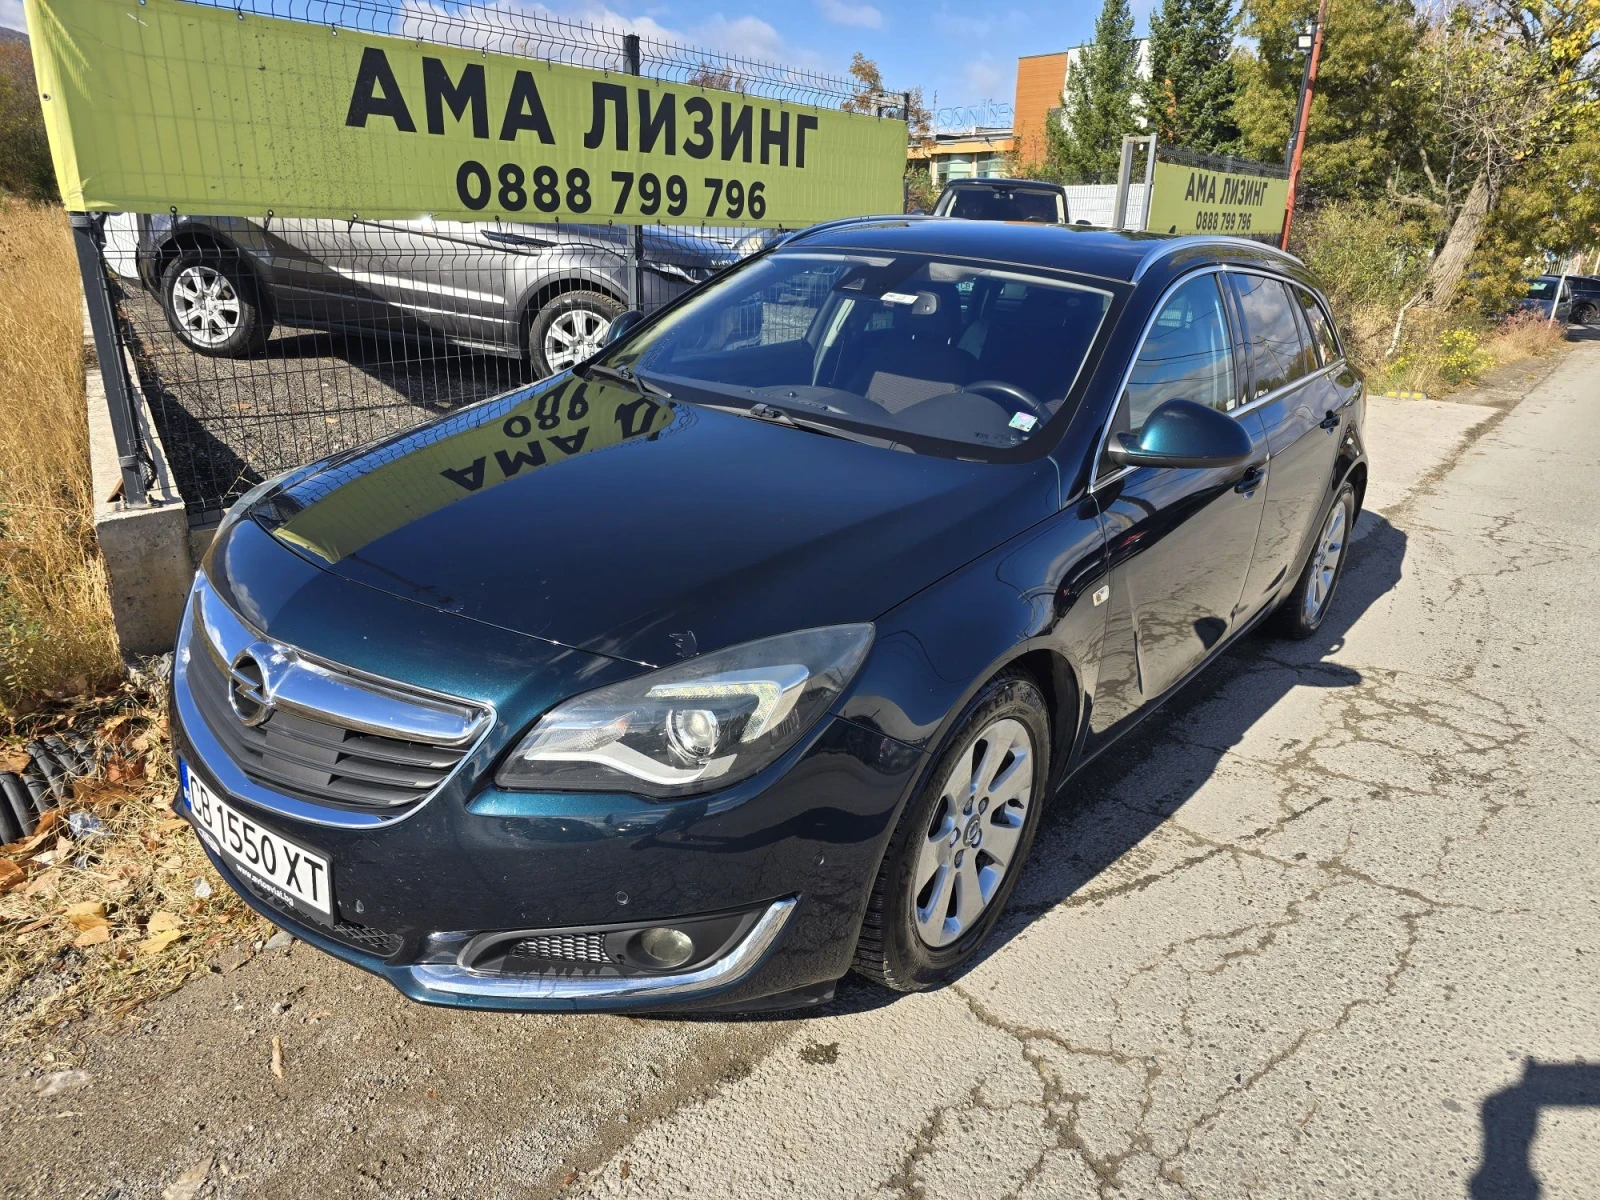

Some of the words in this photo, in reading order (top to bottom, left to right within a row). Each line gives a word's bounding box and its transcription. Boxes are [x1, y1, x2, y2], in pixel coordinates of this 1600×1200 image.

[345, 47, 555, 145] АМА
[584, 82, 818, 167] ЛИЗИНГ
[456, 160, 591, 212] 0888
[611, 171, 688, 216] 799
[705, 178, 767, 220] 796
[1185, 172, 1216, 204] АМА
[1219, 178, 1268, 206] ЛИЗИНГ
[1196, 210, 1218, 230] 0888
[1220, 212, 1236, 231] 799
[1237, 213, 1251, 230] 796
[190, 775, 212, 828] CB
[217, 804, 277, 876] 1550
[283, 845, 323, 902] XT
